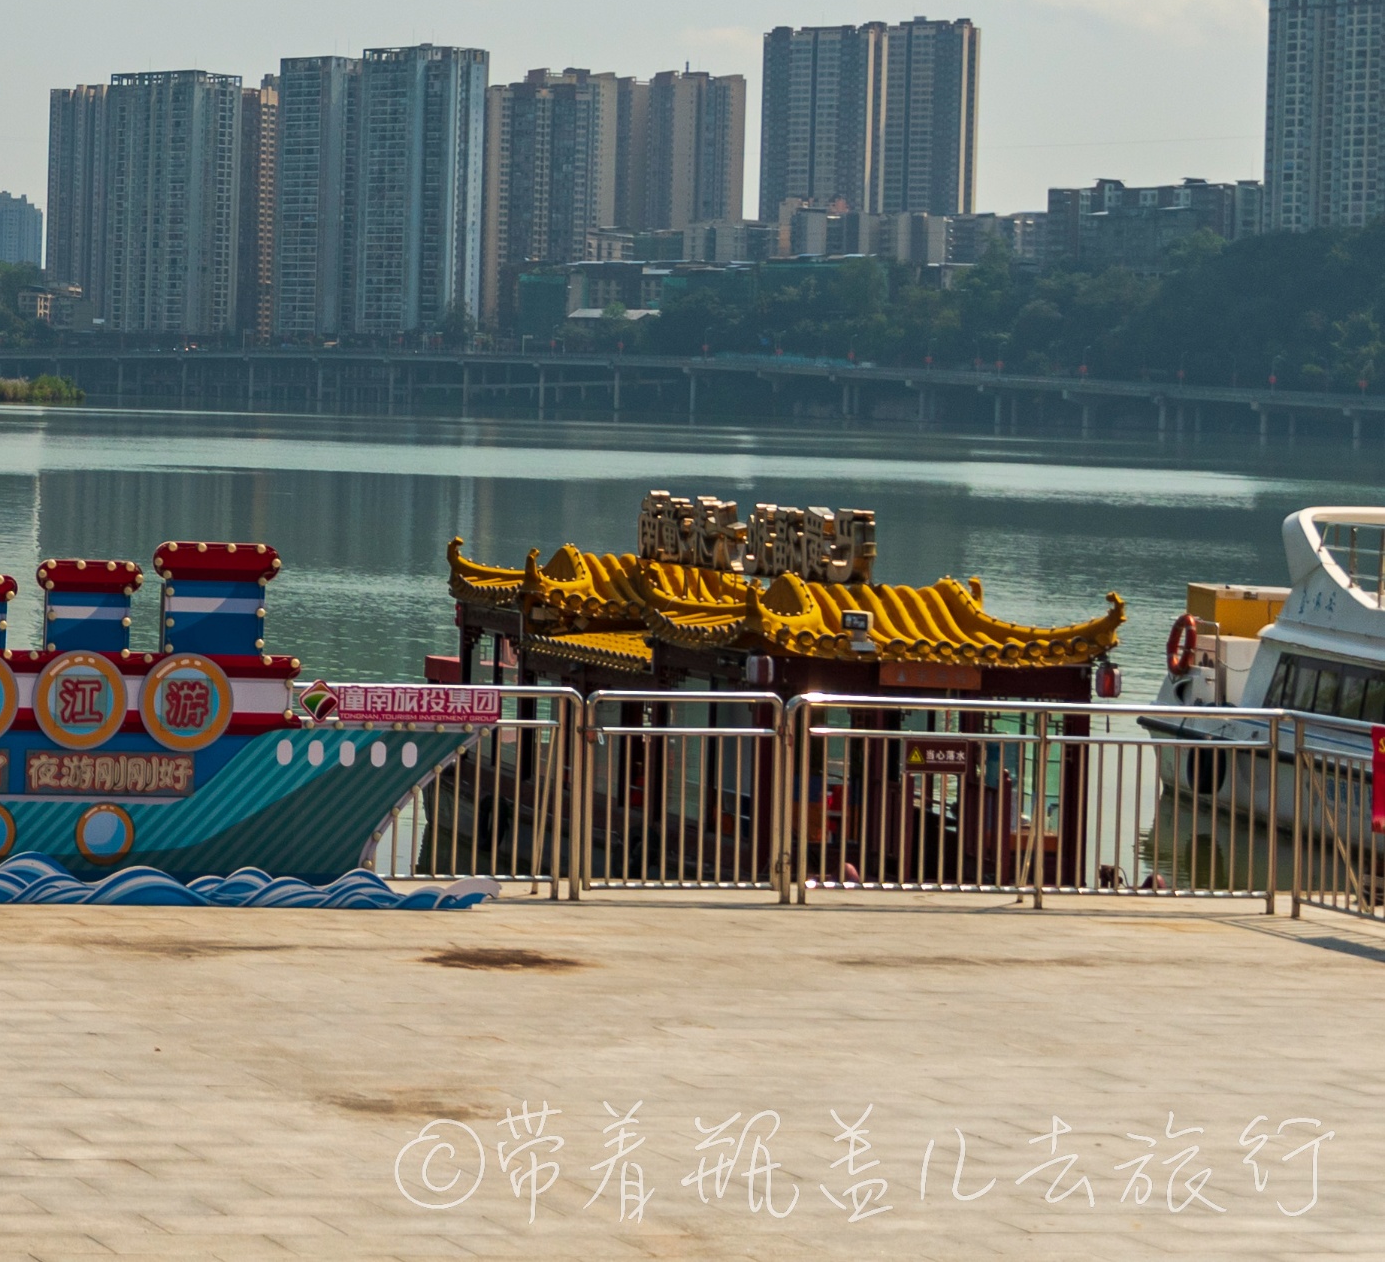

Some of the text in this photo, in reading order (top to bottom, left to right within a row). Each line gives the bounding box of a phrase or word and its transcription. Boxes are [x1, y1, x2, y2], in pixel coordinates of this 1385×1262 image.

[339, 687, 499, 714] 潼南旅投集团
[340, 712, 379, 720] TONGNAN
[926, 749, 965, 760] 当心落水
[28, 752, 194, 791] 夜游刚刚好
